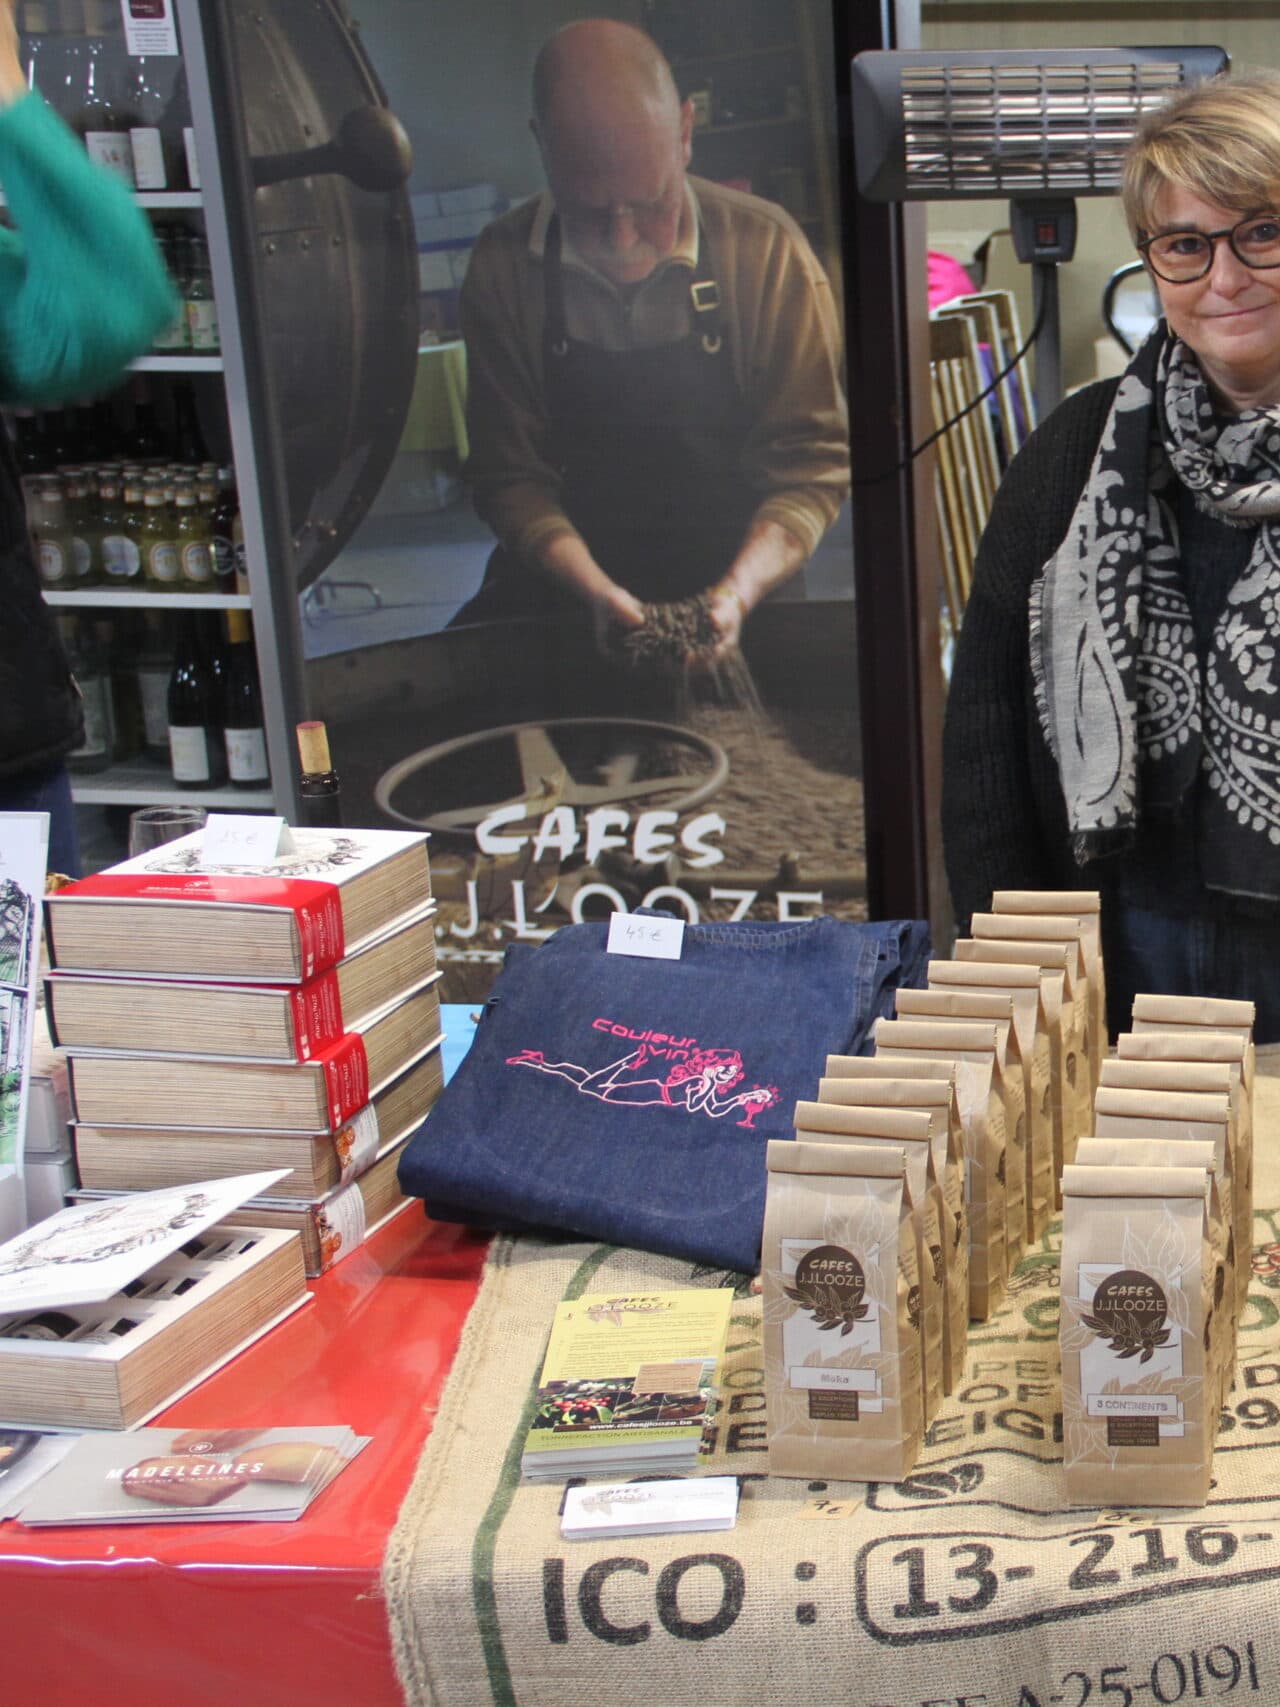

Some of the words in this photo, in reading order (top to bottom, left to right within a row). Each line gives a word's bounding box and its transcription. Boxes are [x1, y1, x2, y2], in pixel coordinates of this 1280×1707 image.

[475, 803, 727, 868] CAFES
[808, 1259, 854, 1273] CAFES
[1107, 1285, 1154, 1298] CAFES
[105, 1462, 265, 1480] MADELEINES
[541, 1552, 746, 1646] ICO
